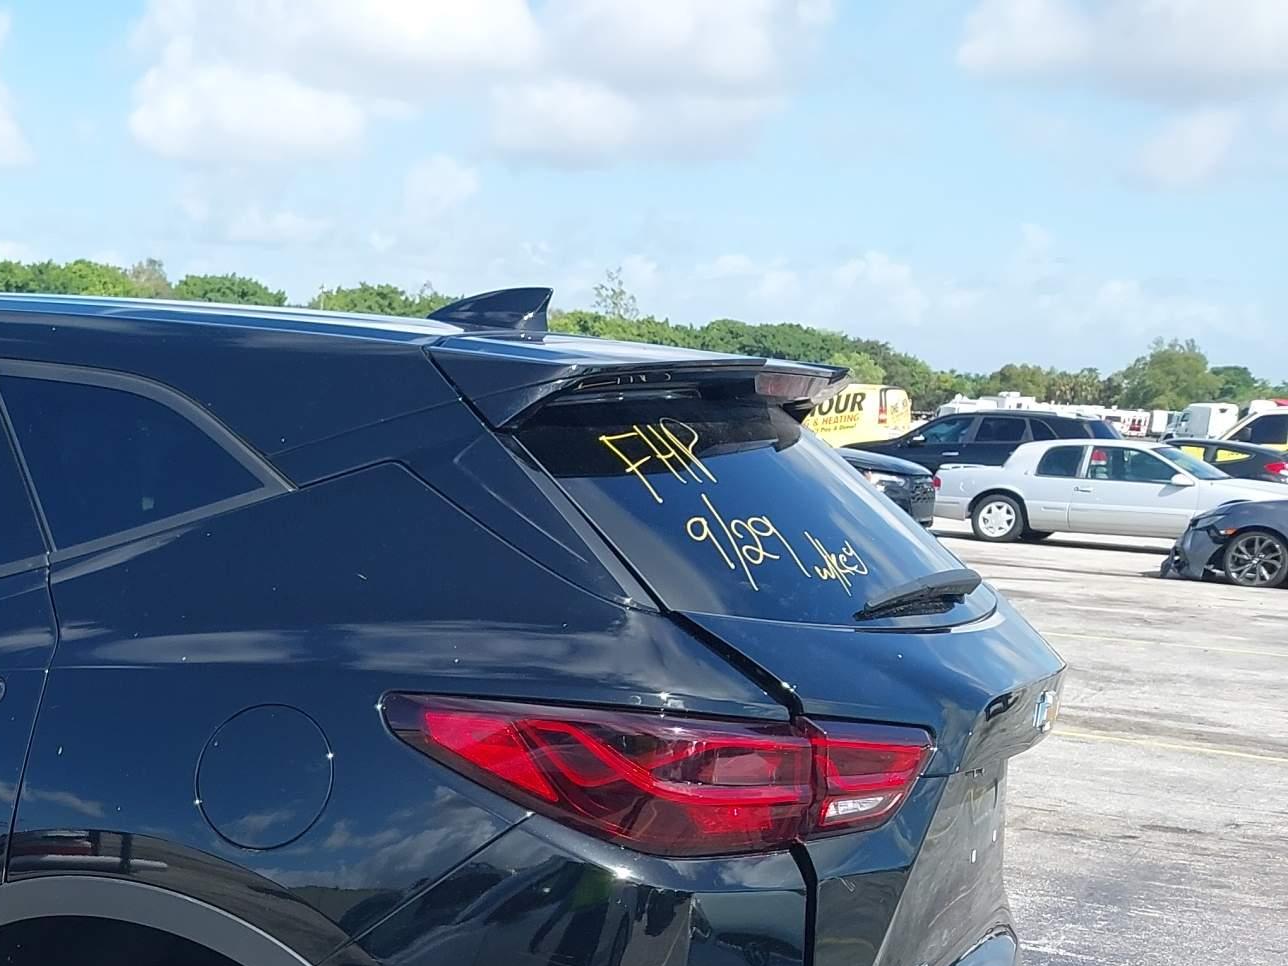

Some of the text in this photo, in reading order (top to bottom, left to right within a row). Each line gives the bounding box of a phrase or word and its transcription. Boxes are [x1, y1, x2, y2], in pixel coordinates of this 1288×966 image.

[810, 392, 866, 417] OUR
[822, 413, 860, 425] HEATING
[686, 493, 812, 591] 9/29
